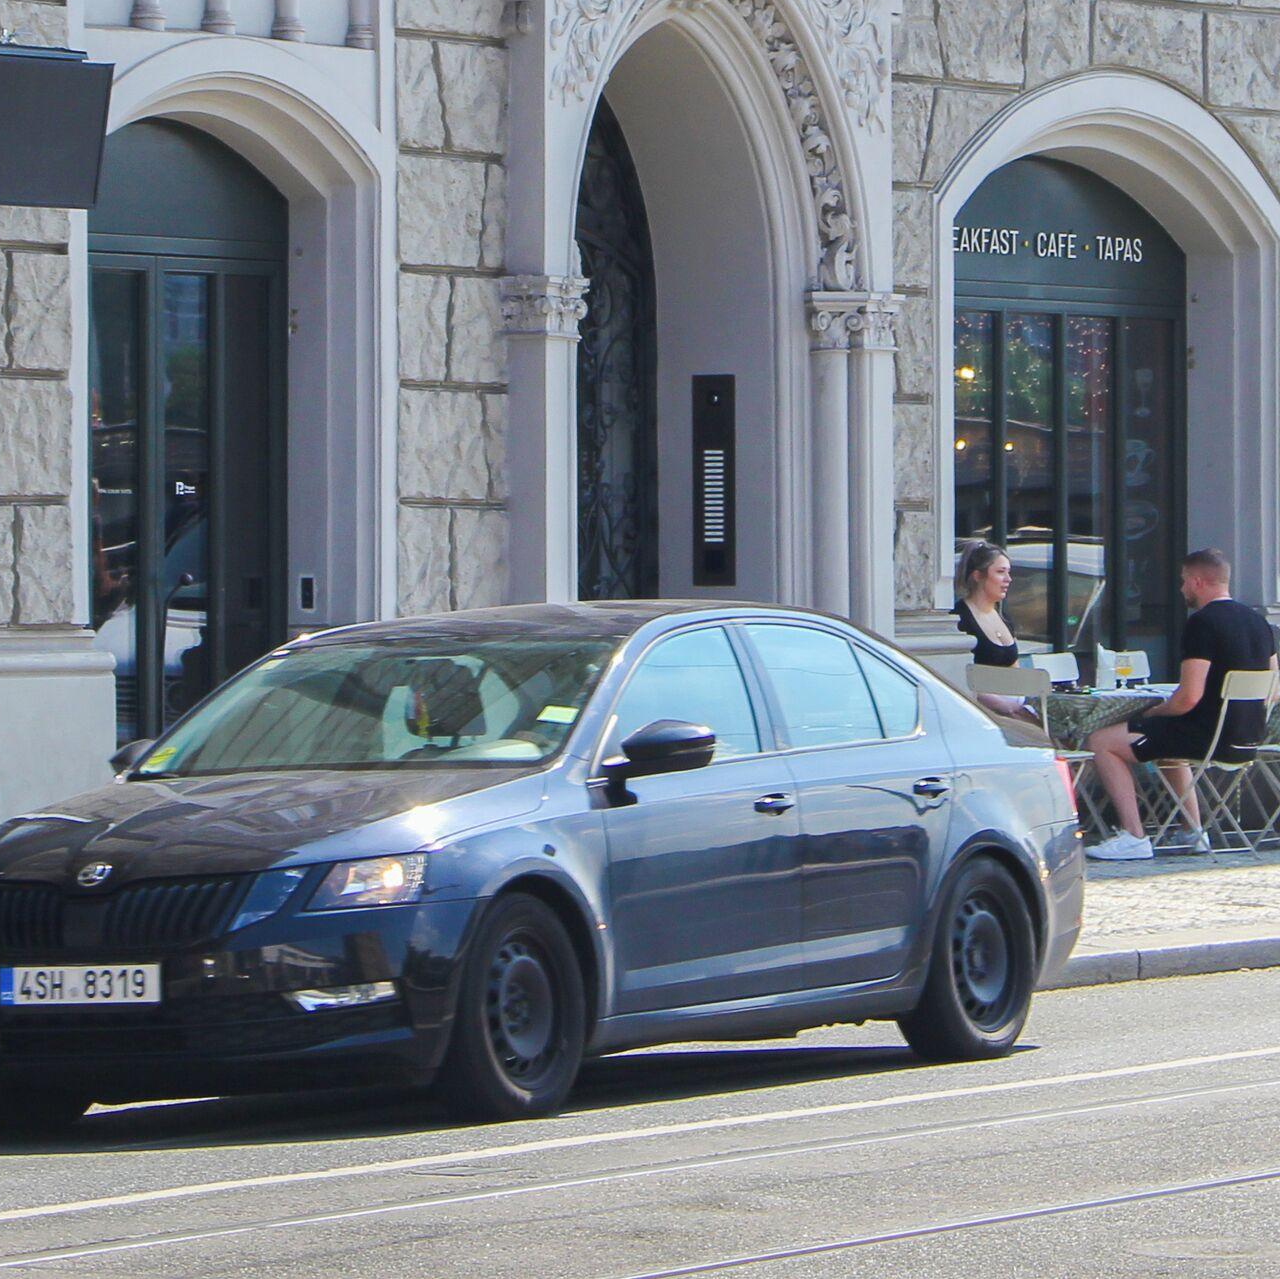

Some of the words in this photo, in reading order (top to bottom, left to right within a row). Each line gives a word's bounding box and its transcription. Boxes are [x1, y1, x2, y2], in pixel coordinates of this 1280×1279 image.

[1096, 235, 1143, 263] TAPAS
[20, 970, 64, 1001] 4SH
[84, 968, 146, 999] 8319
